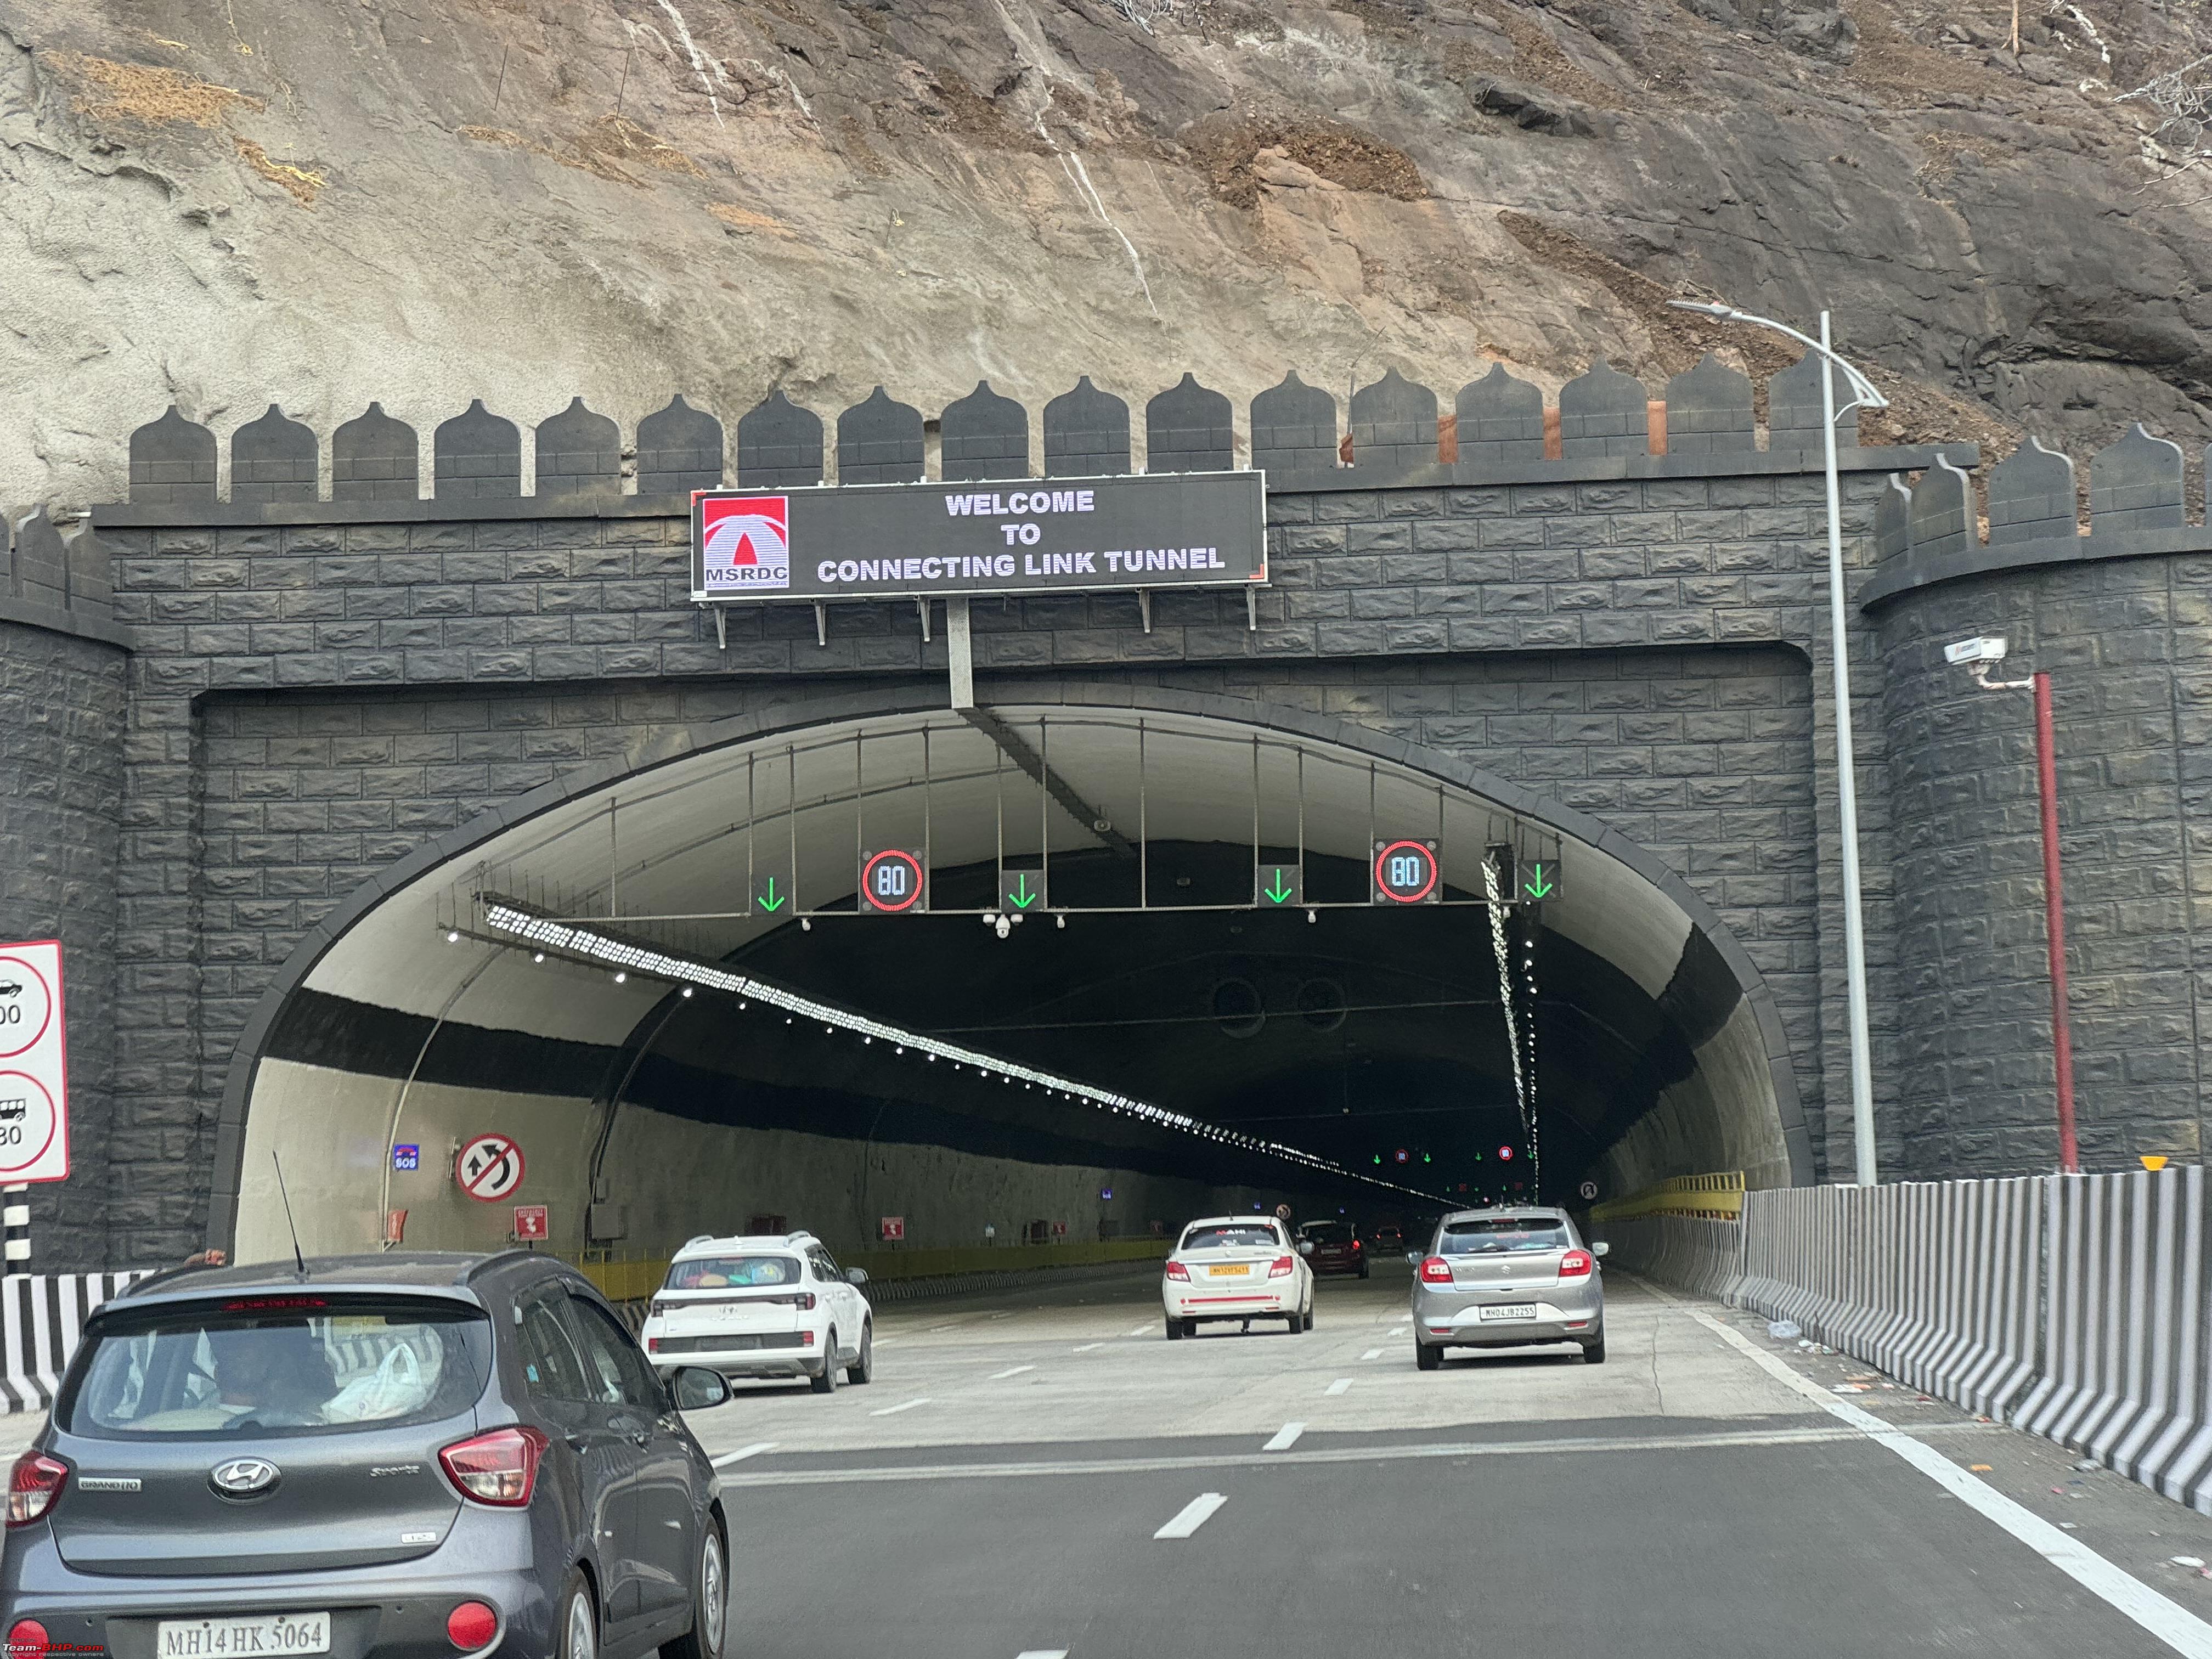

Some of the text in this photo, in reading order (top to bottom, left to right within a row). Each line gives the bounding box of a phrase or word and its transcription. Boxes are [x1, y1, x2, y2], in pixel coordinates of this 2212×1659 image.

[945, 490, 1094, 516] WELCOME
[1001, 523, 1041, 545] TO
[706, 567, 788, 581] MSRDC
[818, 548, 1225, 582] CONNECTING LINK TUNNEL
[878, 865, 905, 895] 80
[1391, 856, 1419, 887] 80
[396, 1158, 416, 1169] SOS
[166, 1622, 321, 1656] MH14 HK 5064
